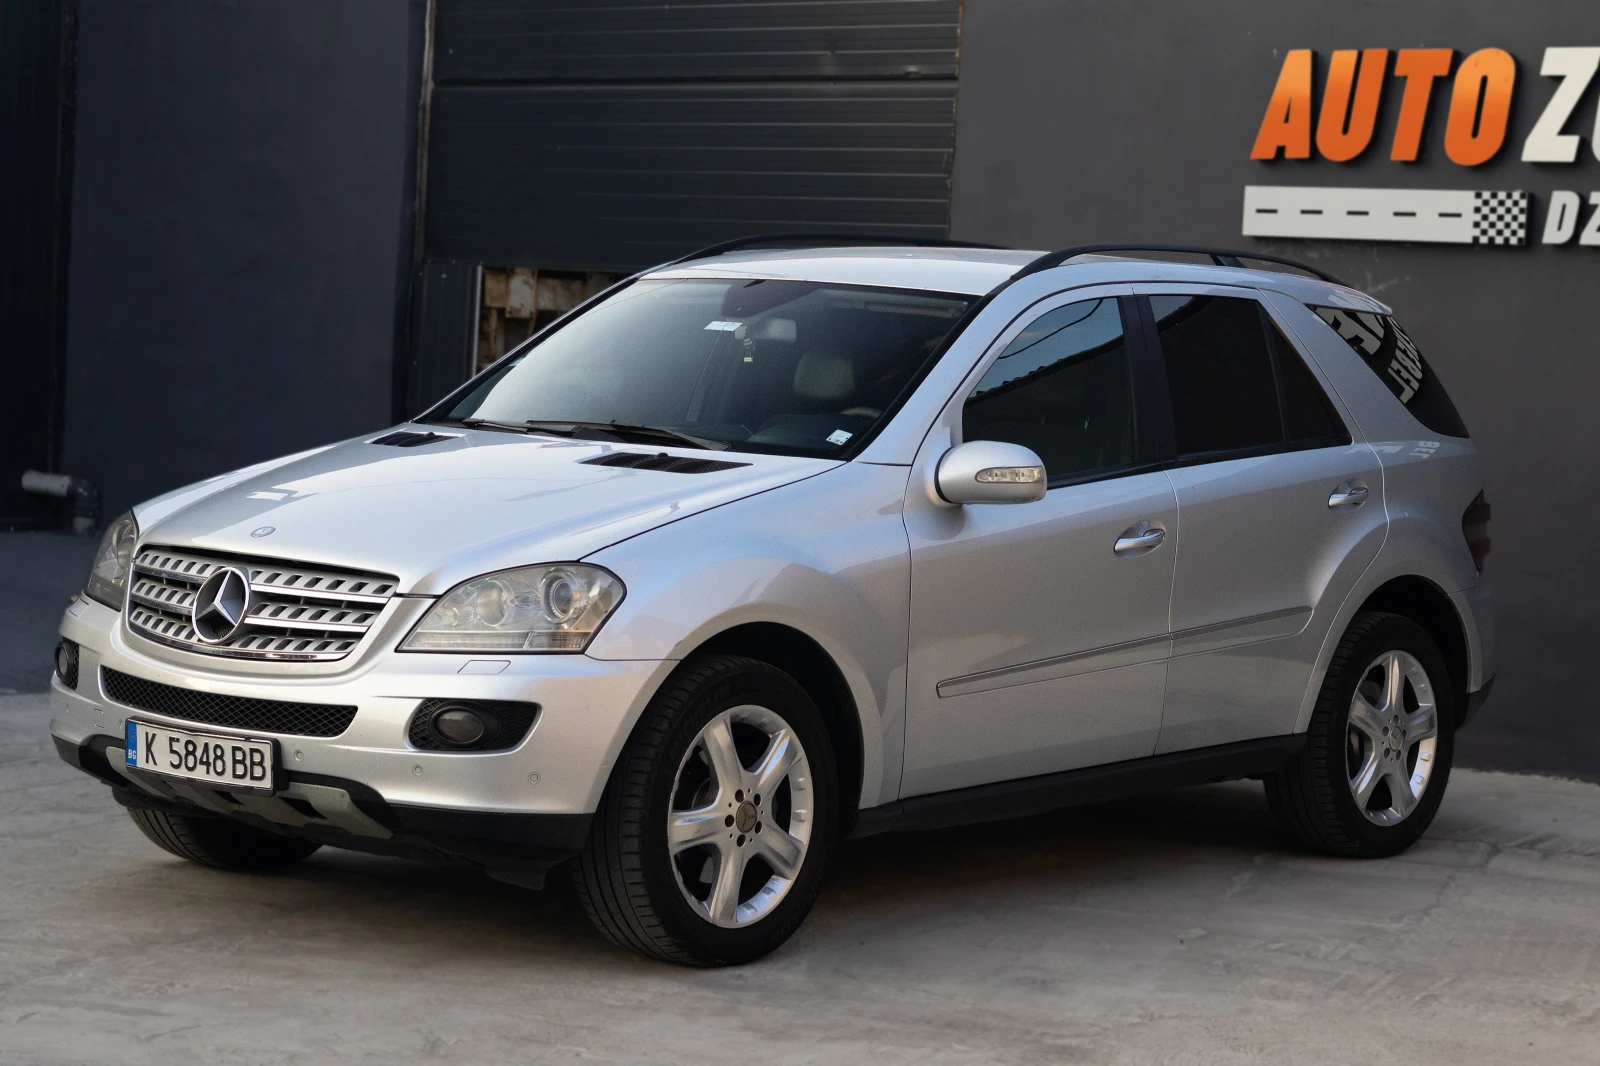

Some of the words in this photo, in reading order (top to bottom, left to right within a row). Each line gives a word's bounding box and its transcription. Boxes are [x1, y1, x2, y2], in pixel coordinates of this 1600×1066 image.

[1250, 48, 1516, 166] AUTO
[1521, 46, 1600, 163] Z
[127, 748, 137, 760] BG
[145, 731, 157, 766] K
[168, 735, 226, 777] 5848
[231, 744, 266, 781] BB
